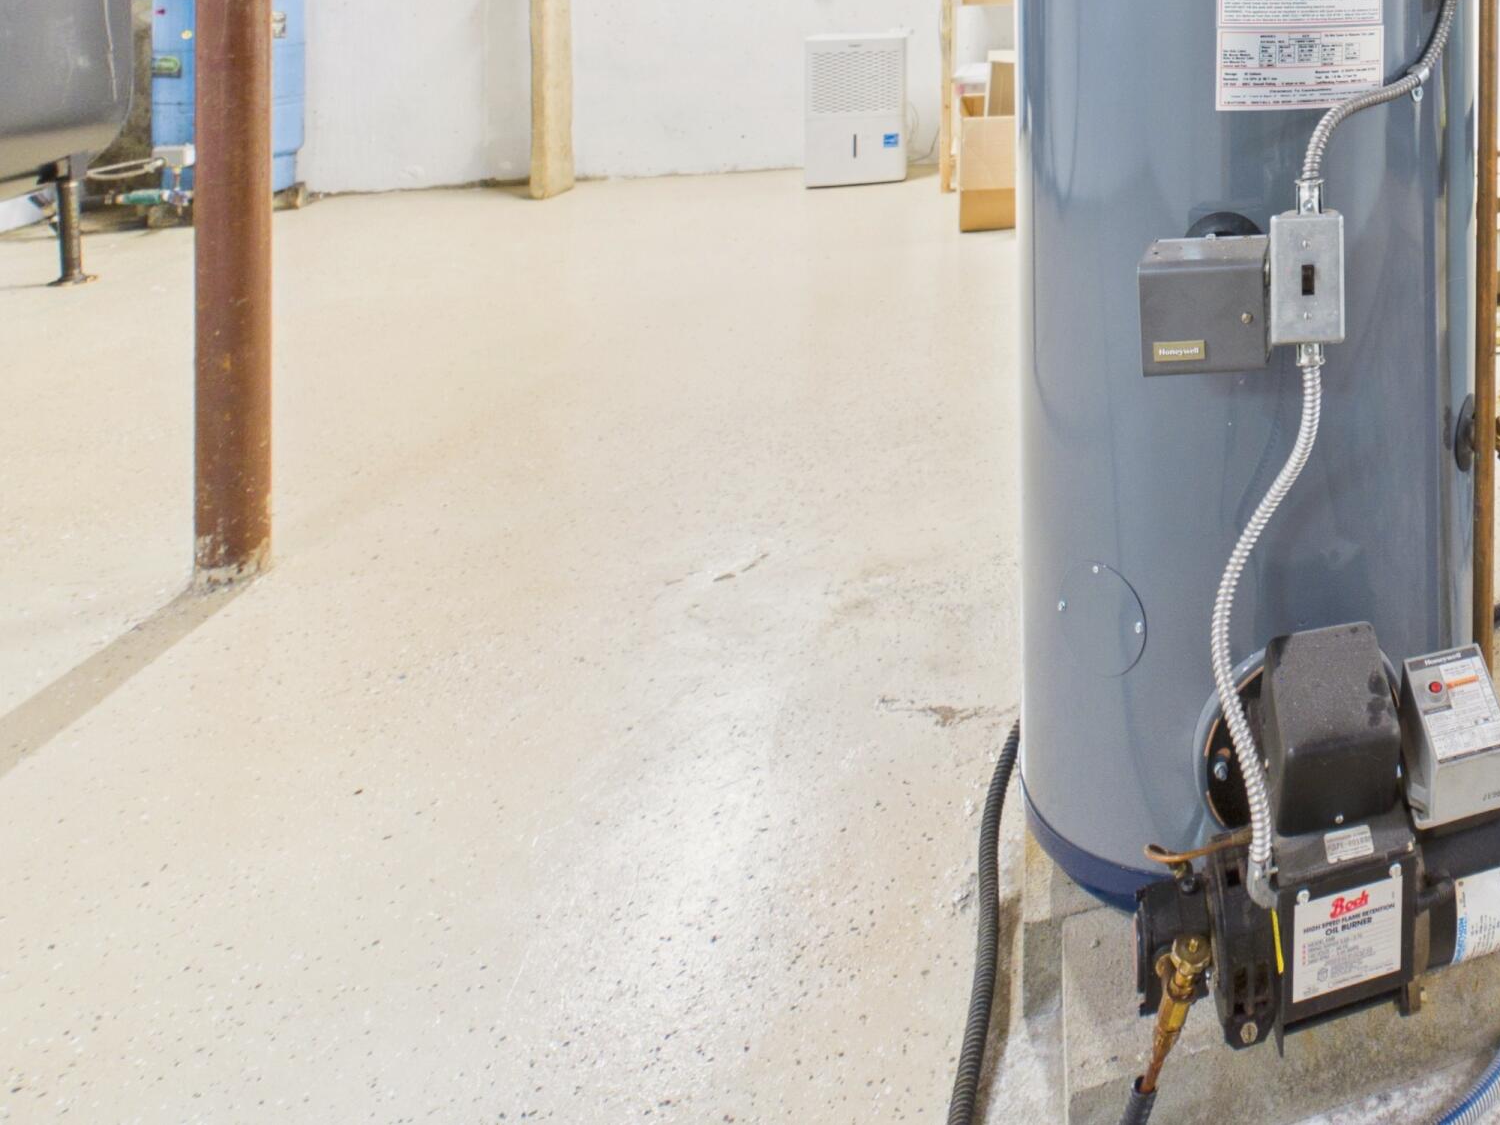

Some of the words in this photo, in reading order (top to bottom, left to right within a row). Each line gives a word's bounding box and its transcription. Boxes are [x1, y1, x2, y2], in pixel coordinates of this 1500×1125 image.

[1158, 346, 1200, 357] Honeywell
[1424, 653, 1462, 666] Honeywell
[1329, 888, 1370, 919] Bock
[1303, 924, 1321, 934] HIGH
[1321, 919, 1341, 930] SPEED
[1341, 913, 1361, 924] FLAME
[1362, 903, 1396, 918] RETENTION
[1325, 927, 1340, 936] OIL
[1341, 918, 1373, 932] BURNER
